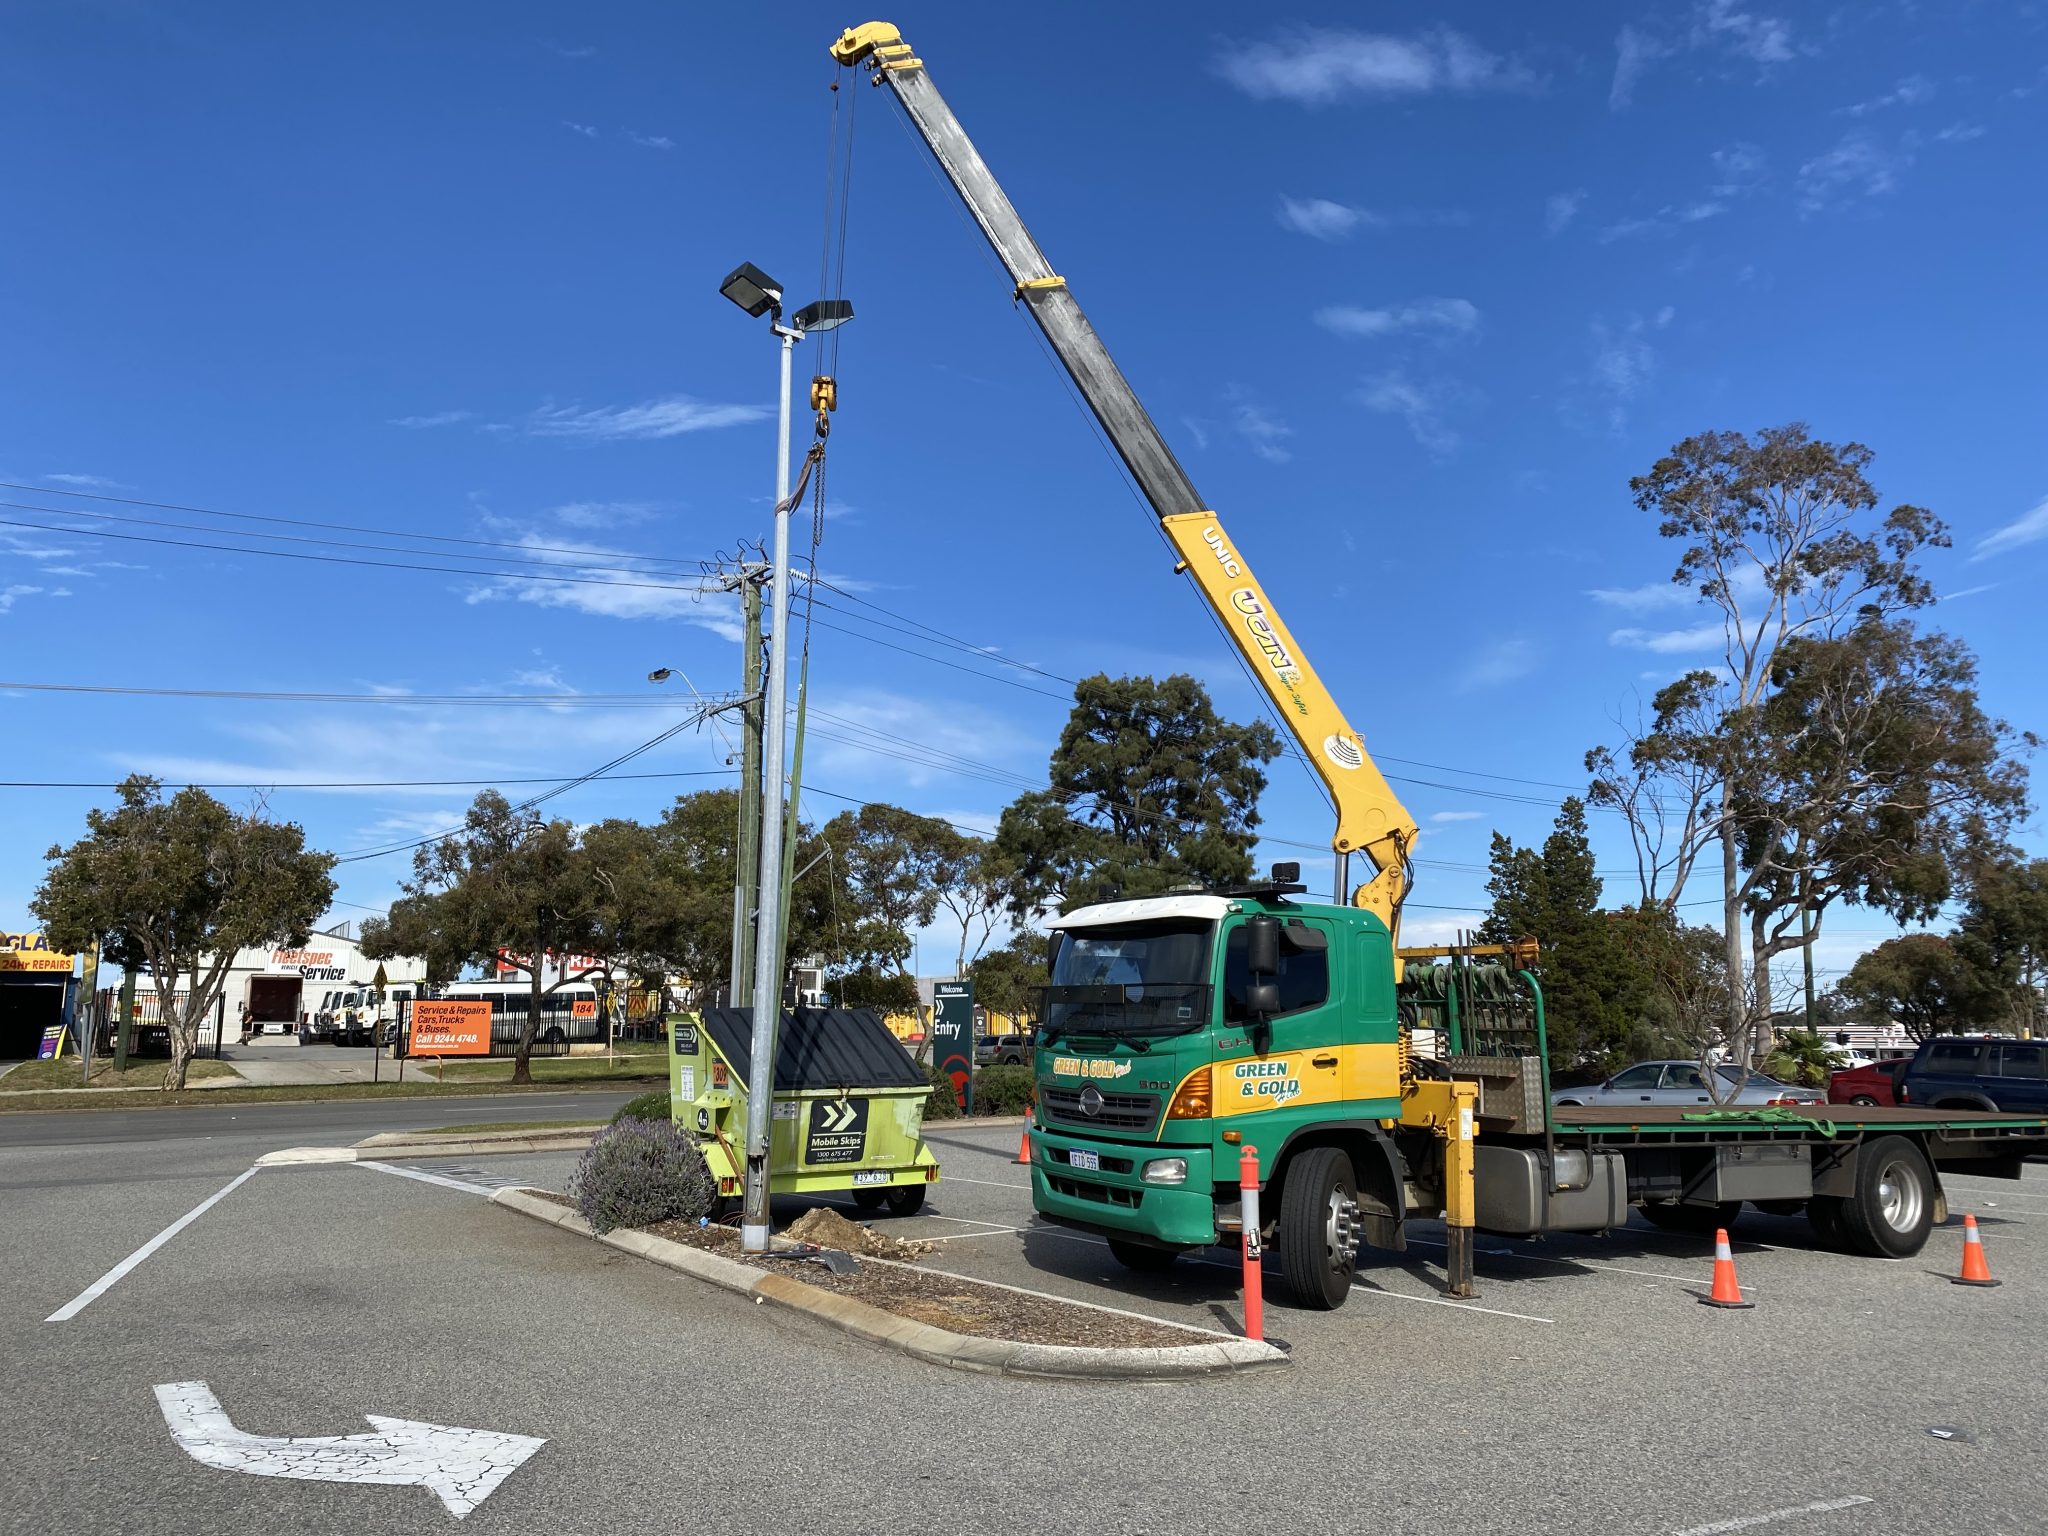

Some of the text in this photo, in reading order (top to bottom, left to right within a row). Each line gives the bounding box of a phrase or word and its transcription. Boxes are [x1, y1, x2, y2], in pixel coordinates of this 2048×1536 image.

[1203, 526, 1240, 578] UNIC
[1233, 590, 1292, 668] UCAN
[2, 960, 71, 970] 24Hr REPAIRS
[298, 965, 345, 981] Service
[941, 984, 963, 994] Welcome
[418, 1006, 486, 1016] Service & Repairs
[575, 1004, 592, 1014] 184
[416, 1025, 451, 1033] & Buses.
[934, 1018, 961, 1041] Entry
[416, 1034, 478, 1043] Call 9244 4748.
[1054, 1058, 1080, 1076] GREEN
[1081, 1060, 1089, 1077] &
[1090, 1060, 1115, 1078] GOLD
[1235, 1062, 1287, 1077] GREEN
[1242, 1080, 1299, 1095] & GOLD
[812, 1136, 861, 1147] Mobile Skips
